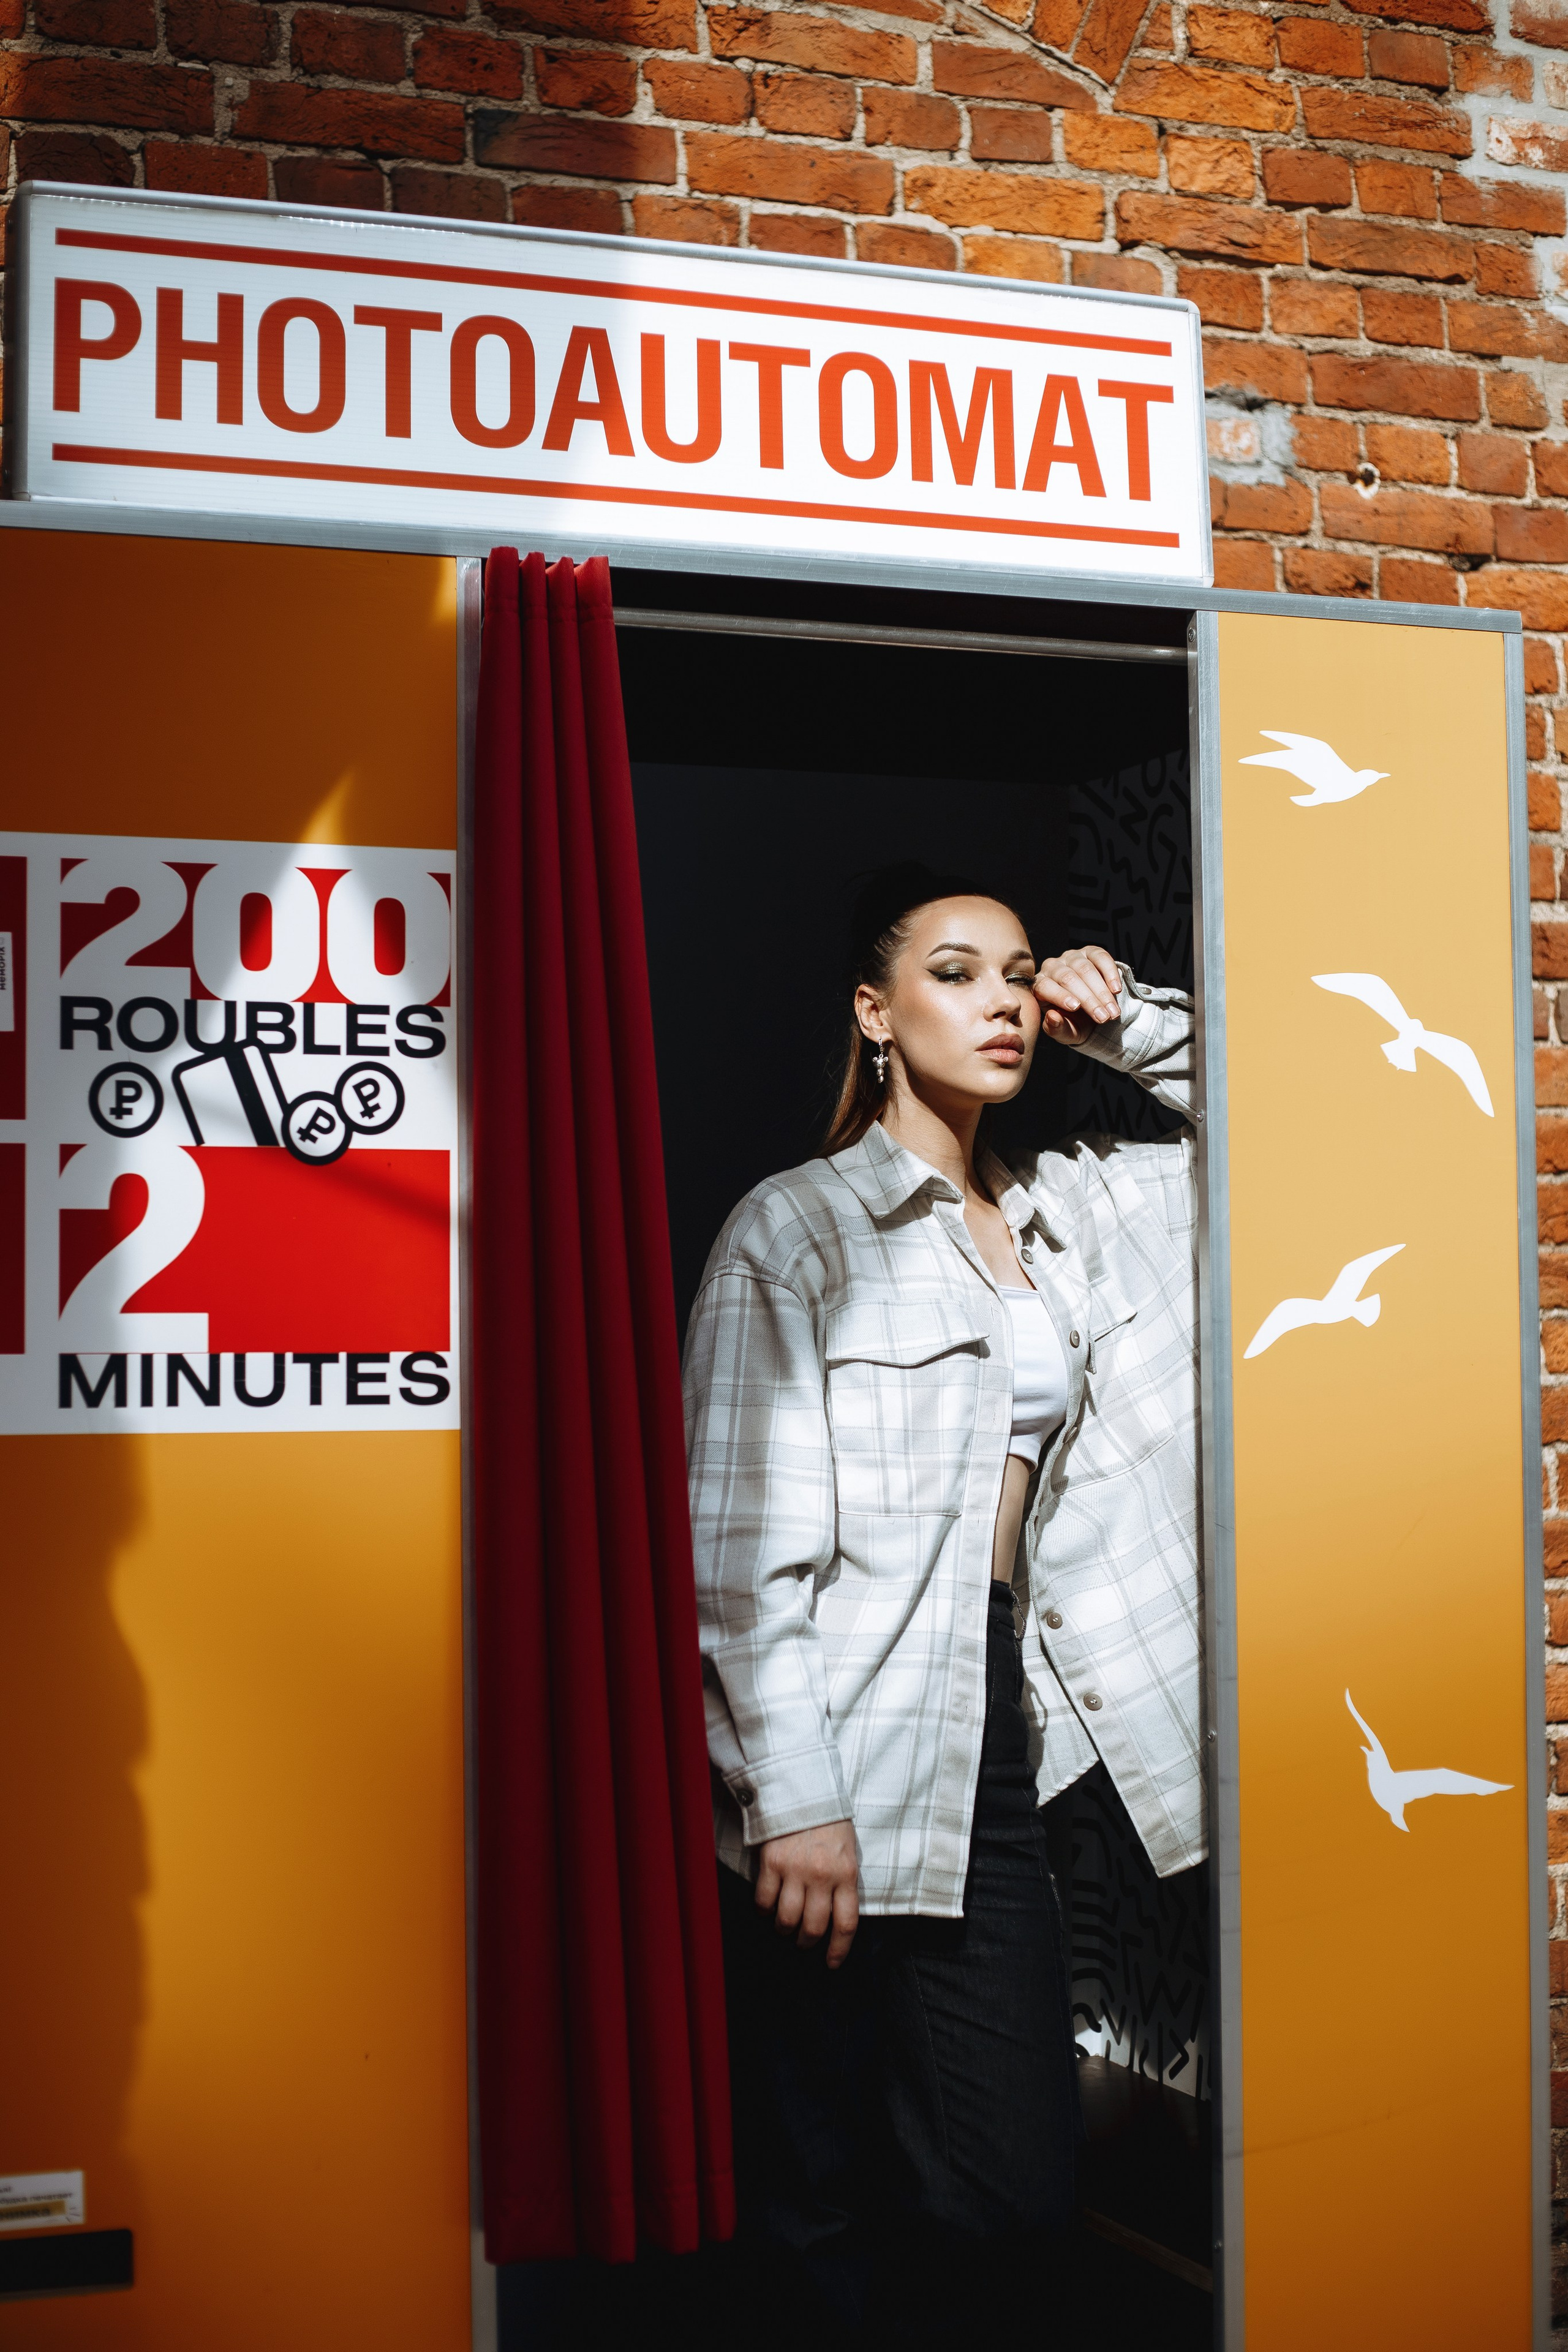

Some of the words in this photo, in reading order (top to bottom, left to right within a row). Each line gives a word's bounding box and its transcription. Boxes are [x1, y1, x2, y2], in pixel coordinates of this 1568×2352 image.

[54, 280, 1174, 501] PHOTOAUTOMAT
[60, 859, 451, 1006] 200
[59, 996, 447, 1058] ROUBLES
[59, 1144, 209, 1353] 2
[59, 1351, 450, 1408] MINUTES
